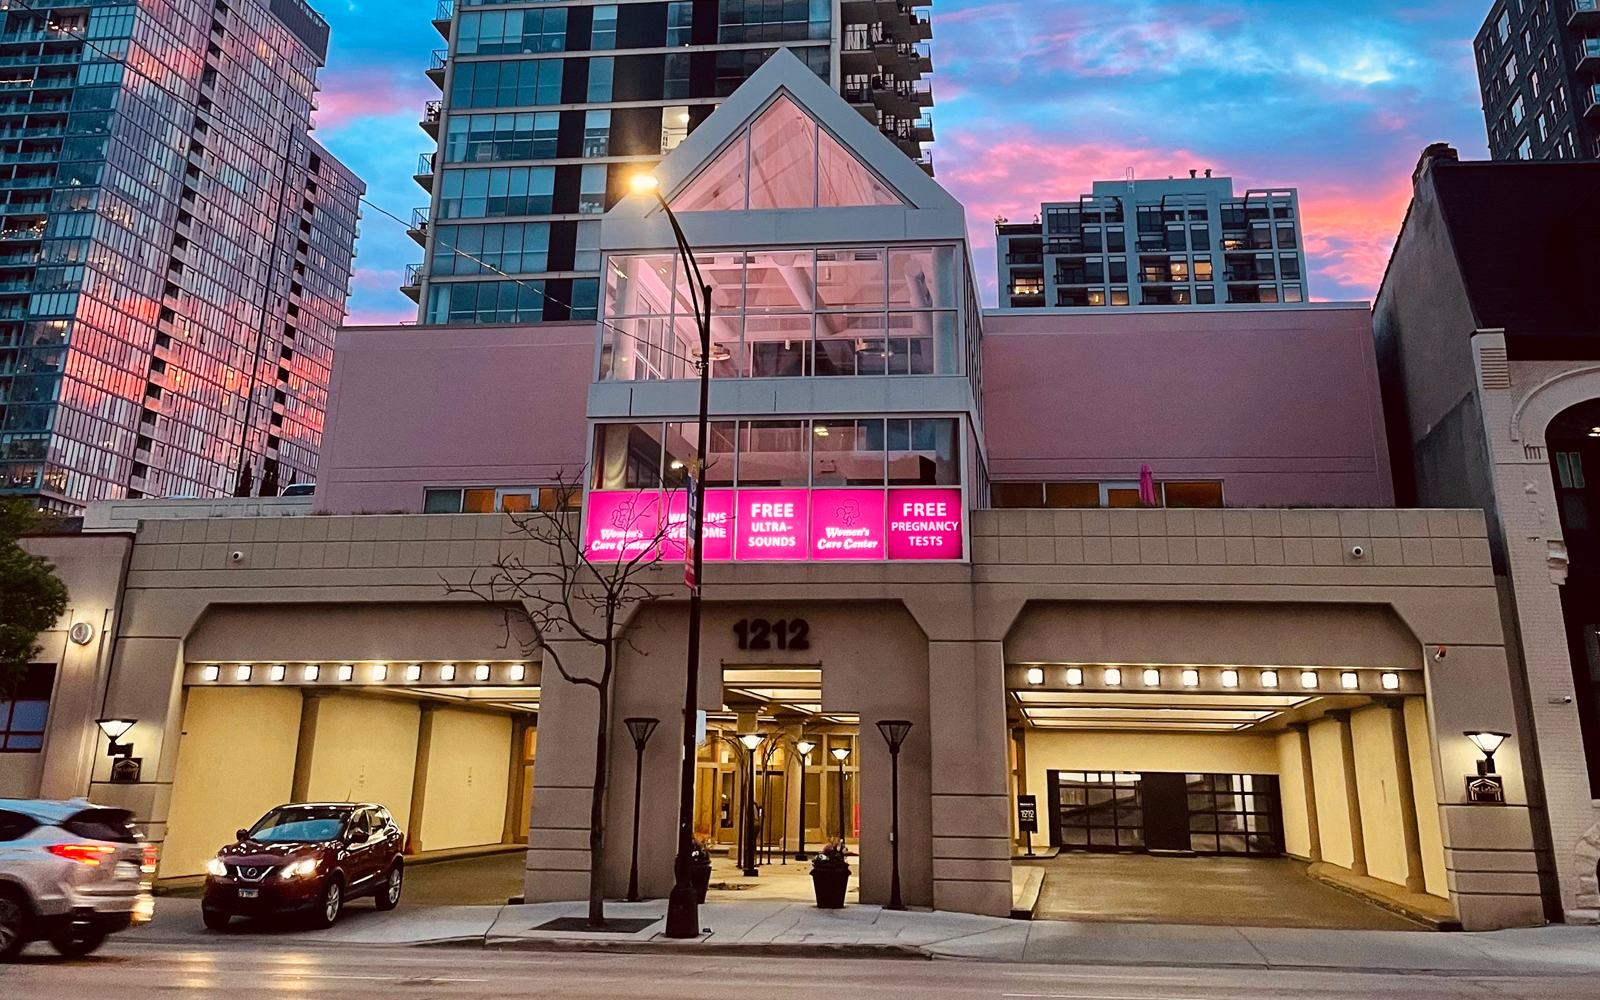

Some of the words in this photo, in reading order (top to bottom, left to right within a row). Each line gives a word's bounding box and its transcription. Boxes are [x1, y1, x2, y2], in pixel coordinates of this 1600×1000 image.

[751, 503, 794, 518] FREE
[903, 502, 947, 517] FREE
[668, 512, 727, 524] WA-INS
[751, 521, 793, 532] ULTRA-
[891, 521, 959, 532] PREGNANCY
[667, 527, 727, 538] WEOME
[825, 527, 870, 539] Women's
[591, 540, 616, 551] Care
[748, 536, 796, 547] SOUNDS
[817, 538, 842, 550] Care
[843, 538, 878, 550] Center
[908, 536, 943, 547] TESTS
[733, 618, 810, 651] 1212
